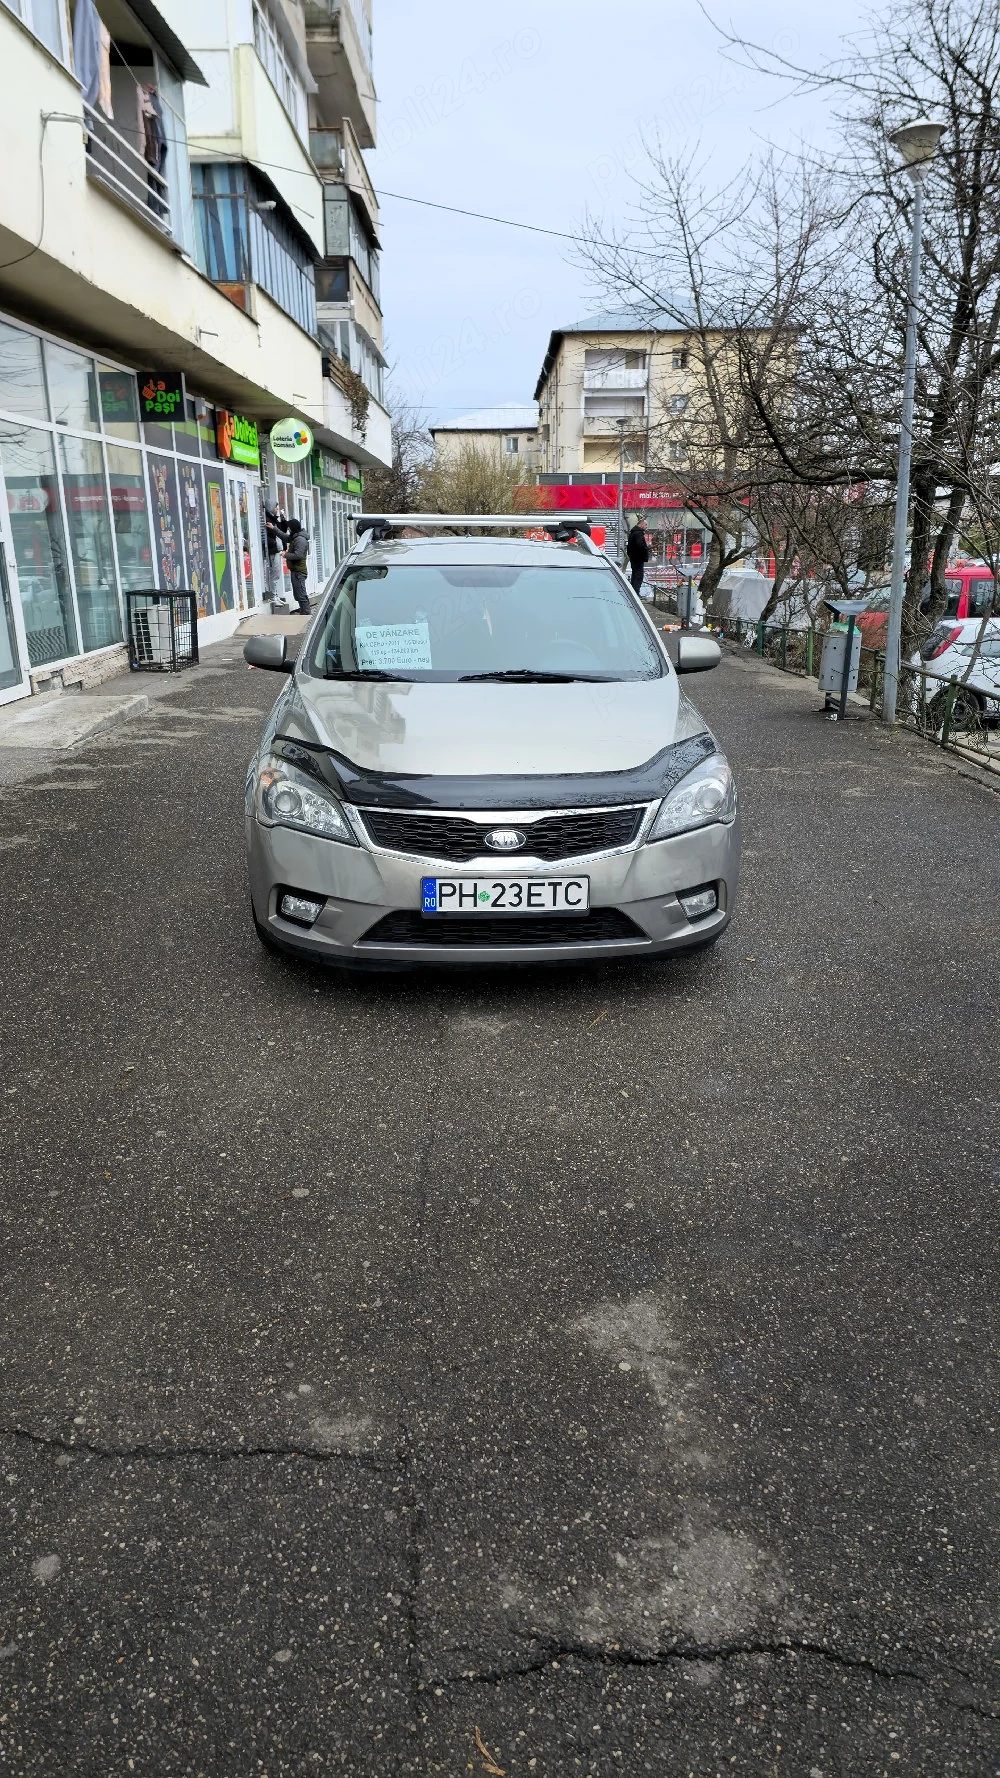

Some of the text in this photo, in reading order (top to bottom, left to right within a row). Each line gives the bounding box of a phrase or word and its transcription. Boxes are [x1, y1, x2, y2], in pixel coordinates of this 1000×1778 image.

[156, 389, 181, 403] Doi
[366, 628, 420, 639] DE VÂNZARE
[396, 656, 412, 664] Euro
[490, 830, 520, 846] KIA
[438, 881, 583, 908] PH 23ETC
[424, 897, 436, 908] RO
